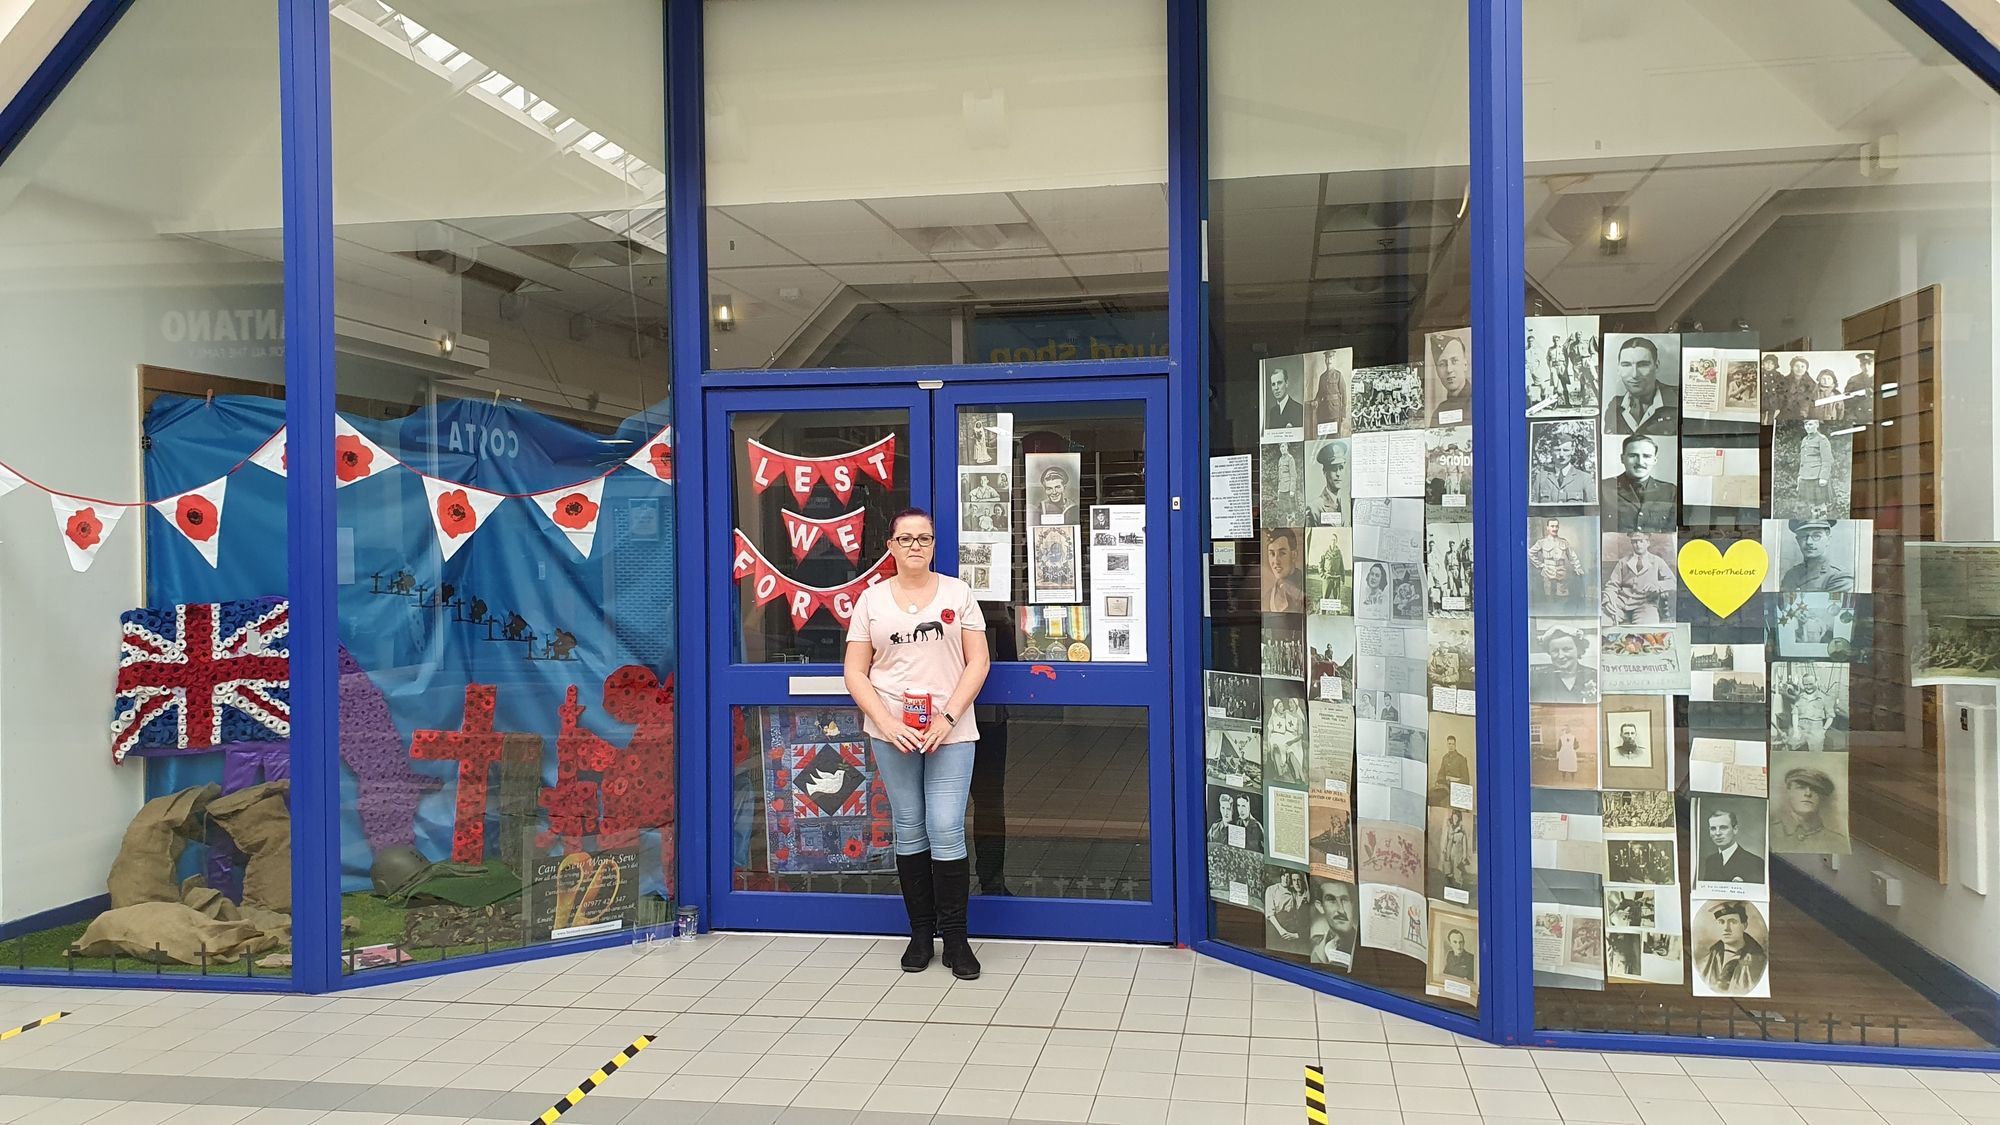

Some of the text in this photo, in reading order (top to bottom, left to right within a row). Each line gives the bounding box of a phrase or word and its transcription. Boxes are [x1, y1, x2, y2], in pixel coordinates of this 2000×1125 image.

[754, 451, 888, 493] LEST
[788, 520, 860, 554] WE
[1688, 568, 1757, 577] #LoveForTheLost
[617, 853, 637, 864] Sew
